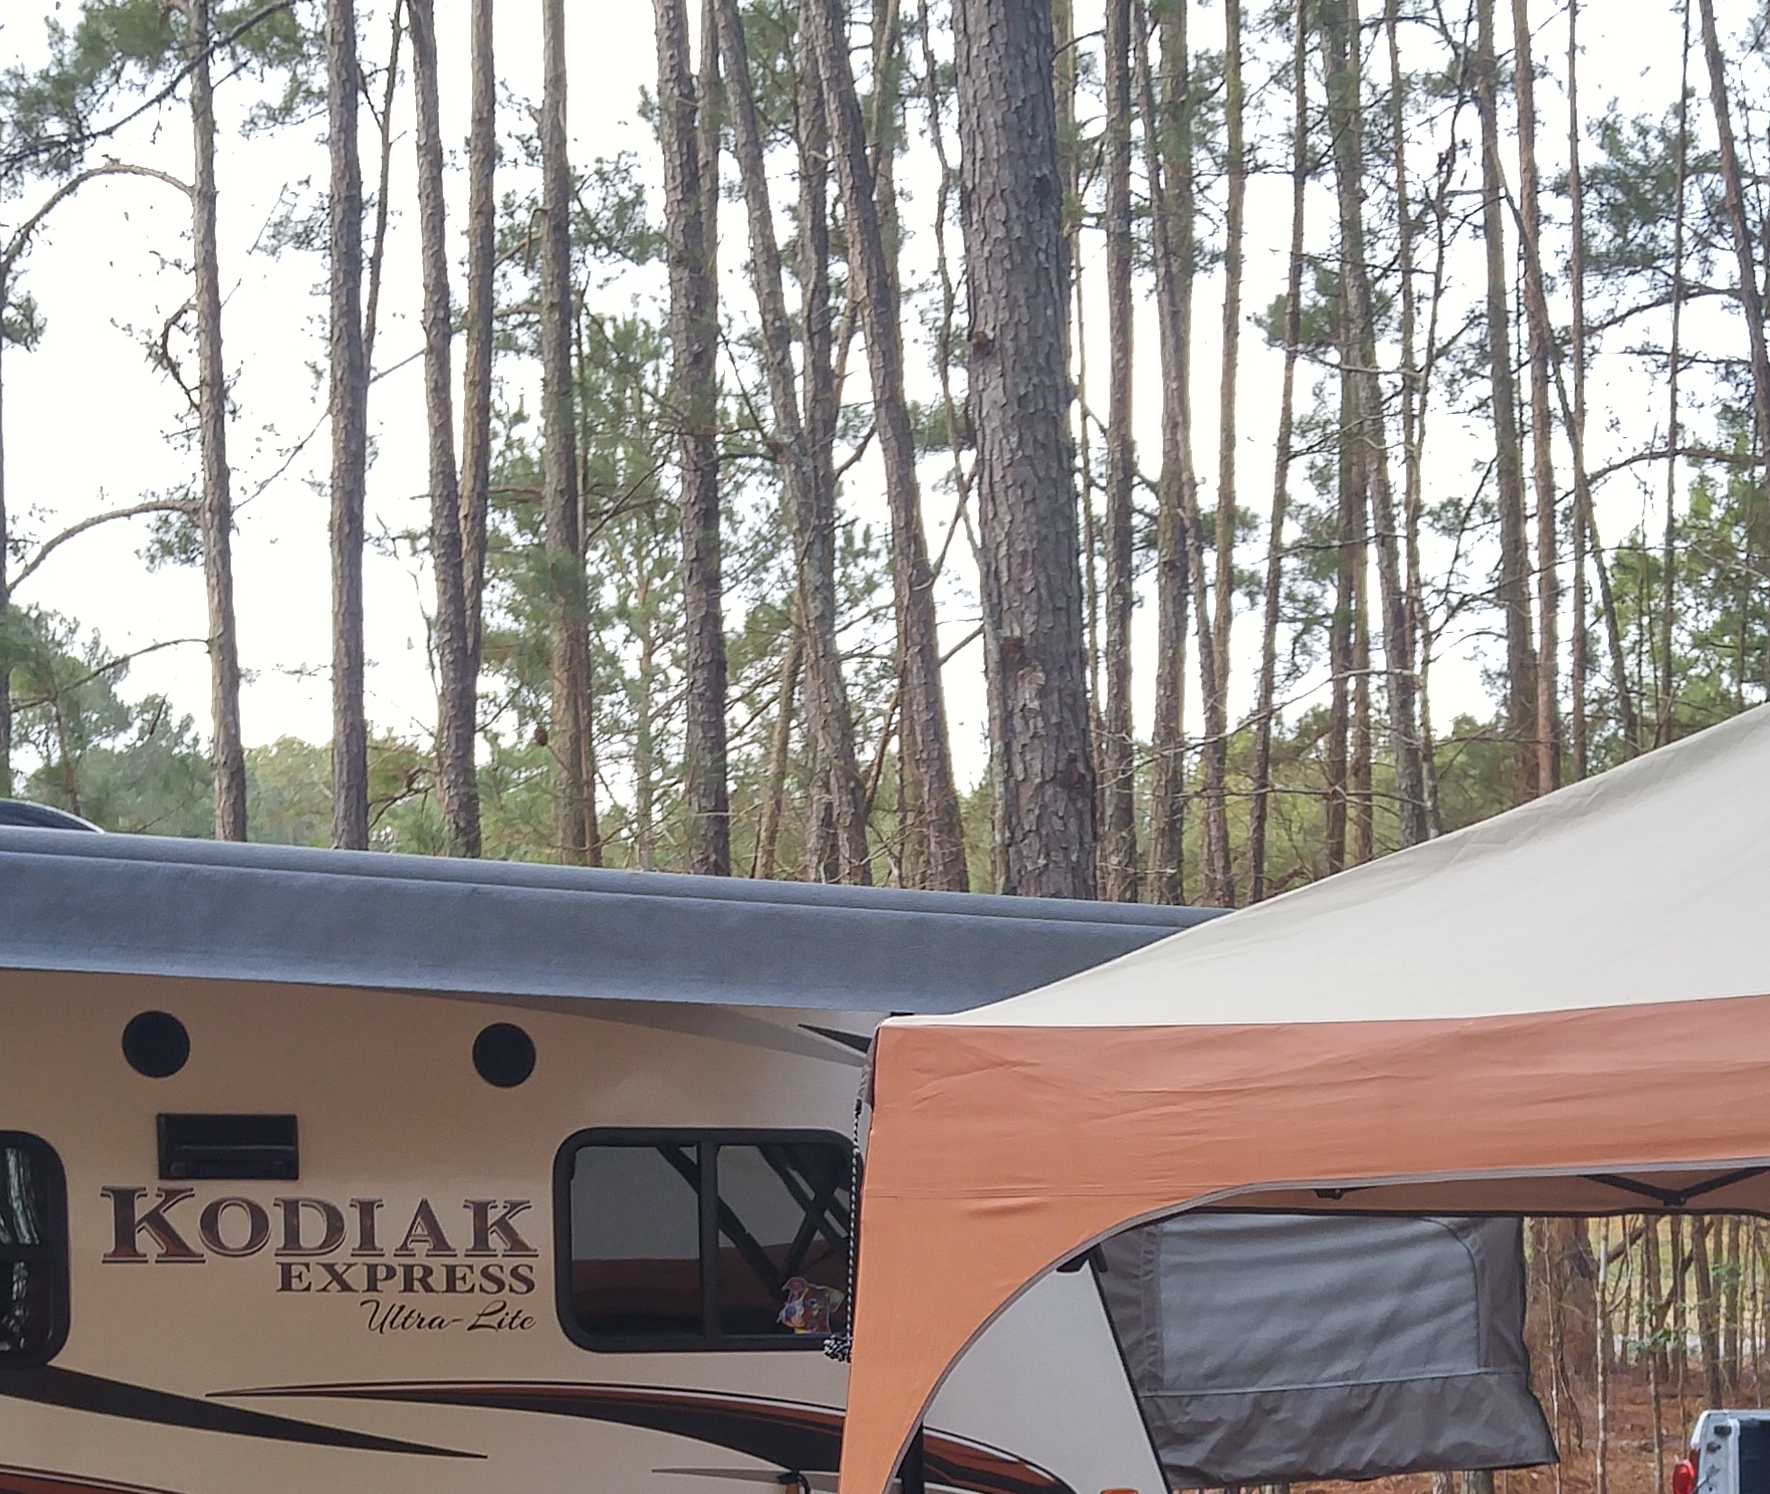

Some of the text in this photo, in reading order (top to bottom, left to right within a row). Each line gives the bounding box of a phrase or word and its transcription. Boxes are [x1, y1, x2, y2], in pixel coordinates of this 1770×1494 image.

[101, 1186, 539, 1264] KODIAK
[275, 1260, 537, 1295] EXPRESS
[359, 1299, 538, 1335] Ultra-Lite
